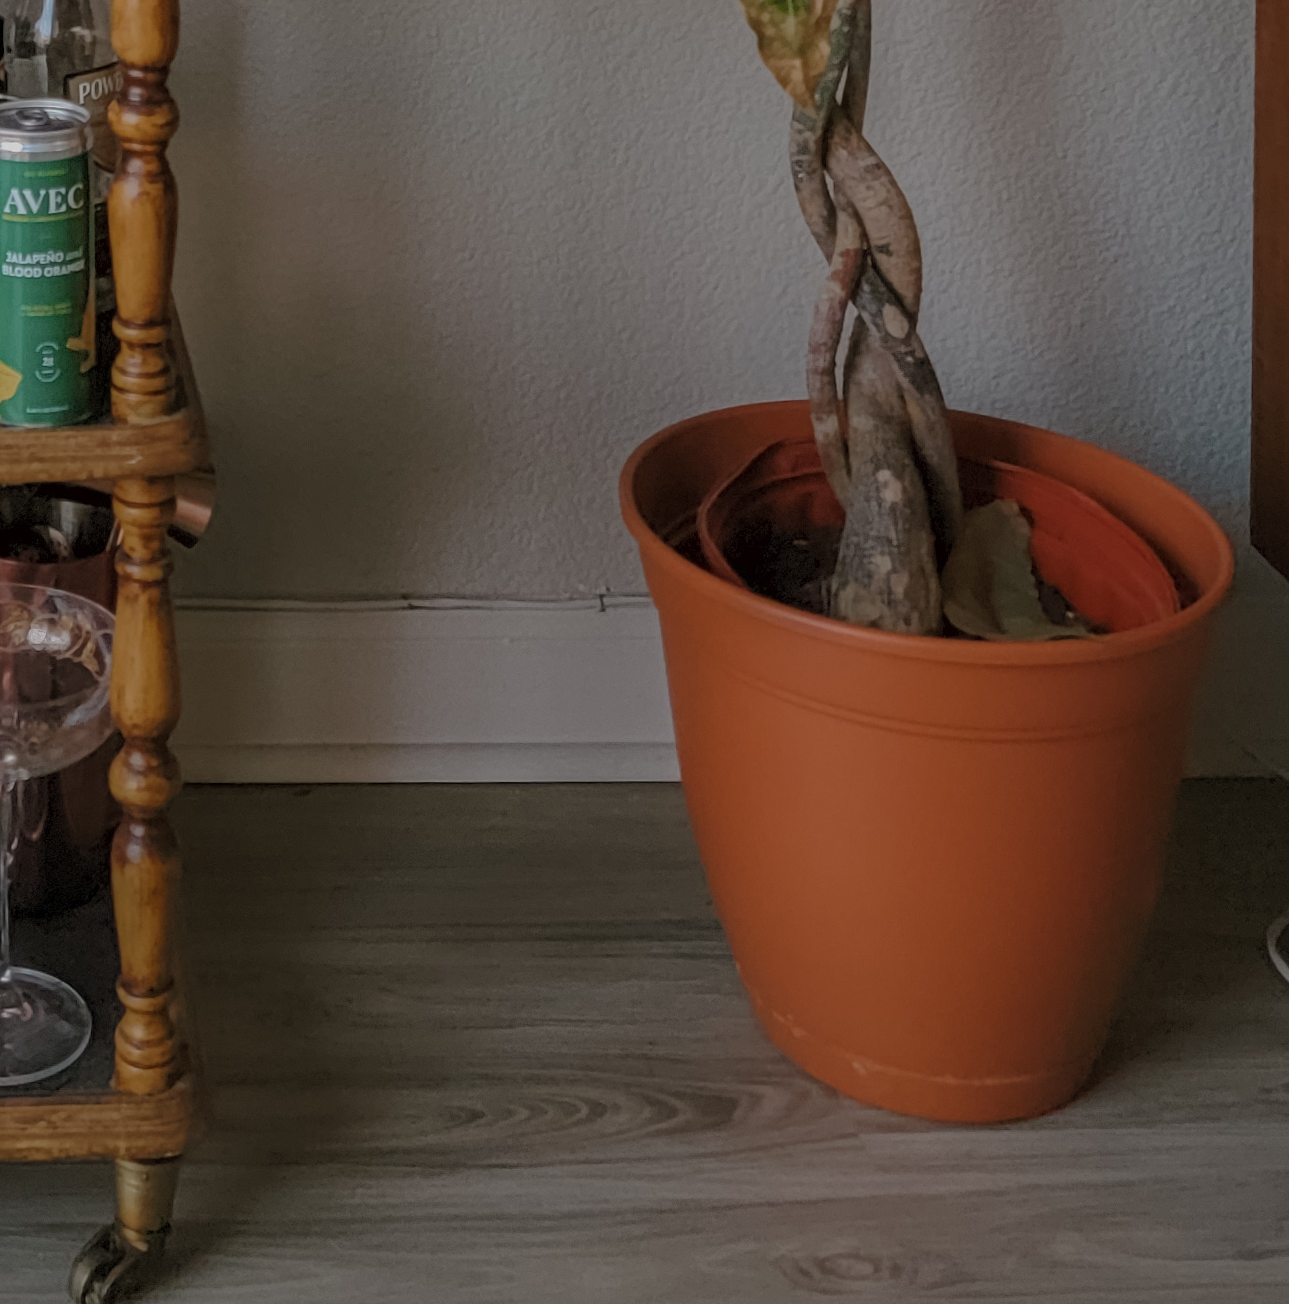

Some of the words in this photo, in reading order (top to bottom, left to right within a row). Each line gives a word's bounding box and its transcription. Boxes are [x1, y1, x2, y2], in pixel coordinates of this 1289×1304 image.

[3, 183, 84, 216] AVEC
[5, 250, 64, 265] JALAPEÑO
[1, 263, 42, 279] BLOOD
